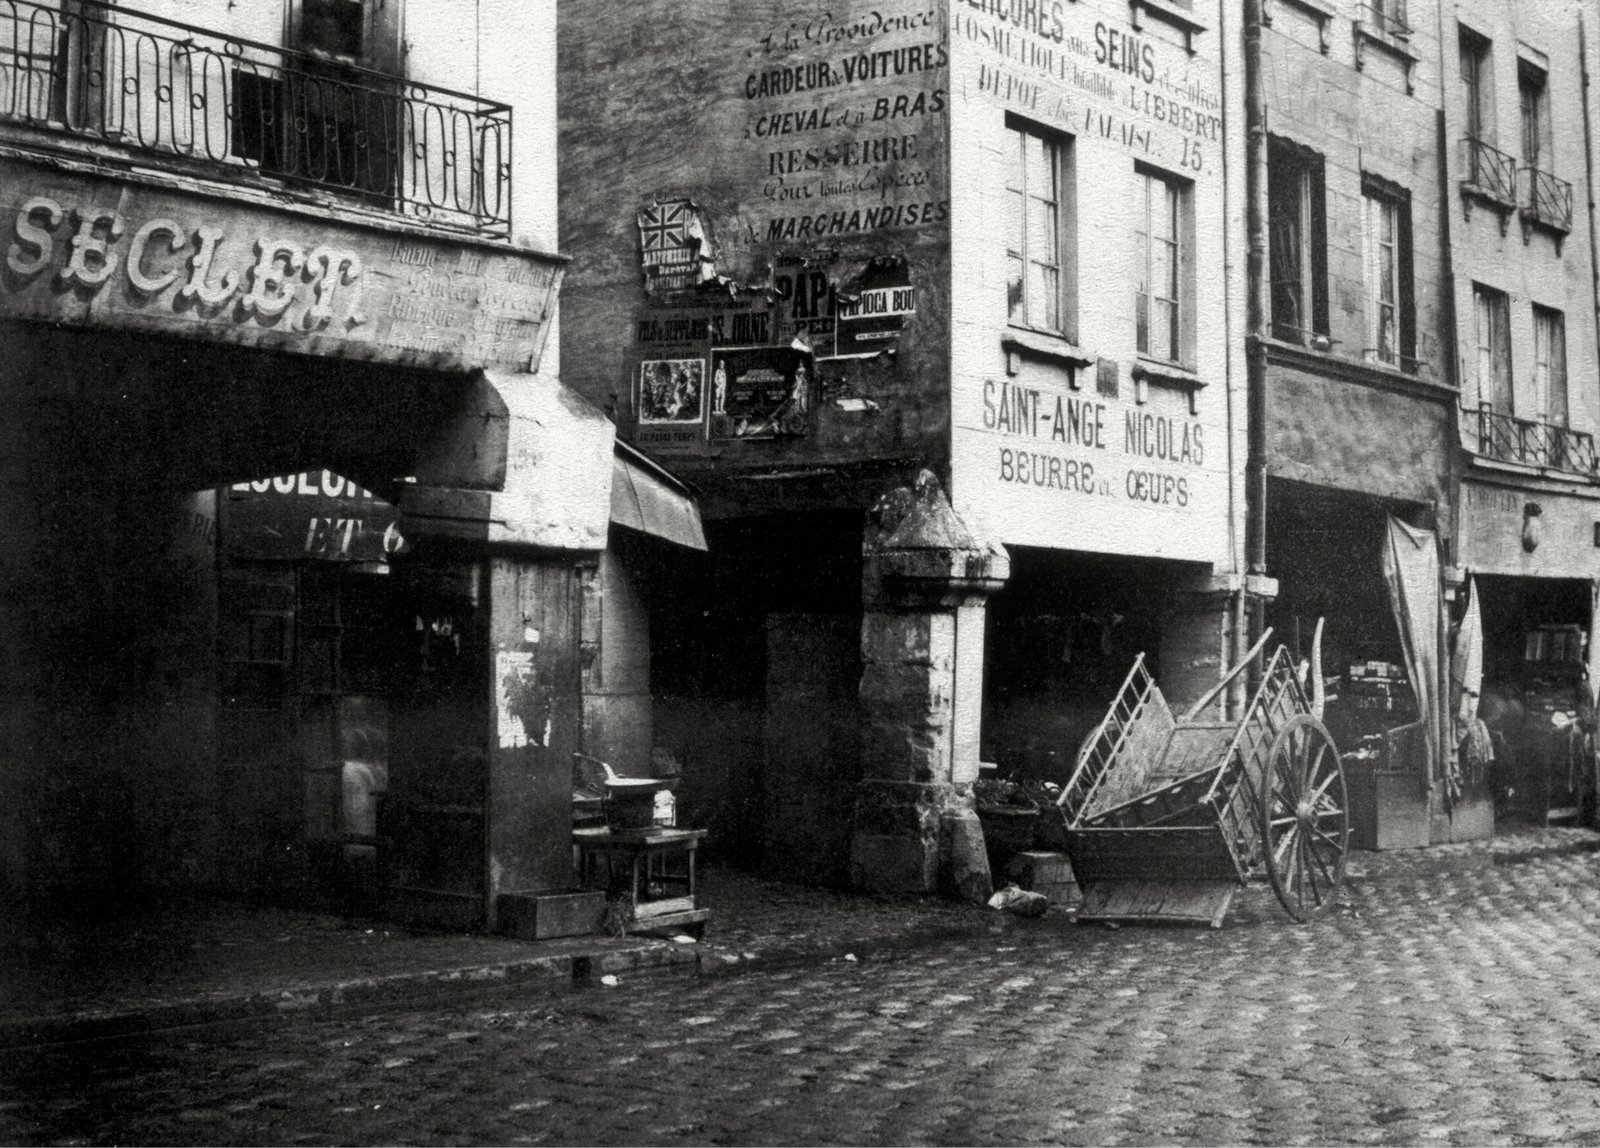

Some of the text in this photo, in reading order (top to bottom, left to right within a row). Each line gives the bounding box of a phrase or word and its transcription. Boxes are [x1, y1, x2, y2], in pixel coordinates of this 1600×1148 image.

[804, 10, 935, 46] Providence
[842, 41, 950, 84] VOITURES
[1094, 21, 1155, 85] SEINS
[755, 107, 832, 138] CHEVAL
[872, 88, 947, 122] BRAS
[1129, 85, 1221, 142] LIEBERT
[768, 134, 919, 177] RESSERRE
[762, 175, 813, 202] Pour
[765, 200, 950, 243] MARCHANDISES
[774, 271, 836, 319] PAP
[983, 379, 1204, 466] SAINT-ANGE NICOLAS
[998, 446, 1095, 496] BEURRE
[304, 517, 363, 554] ET
